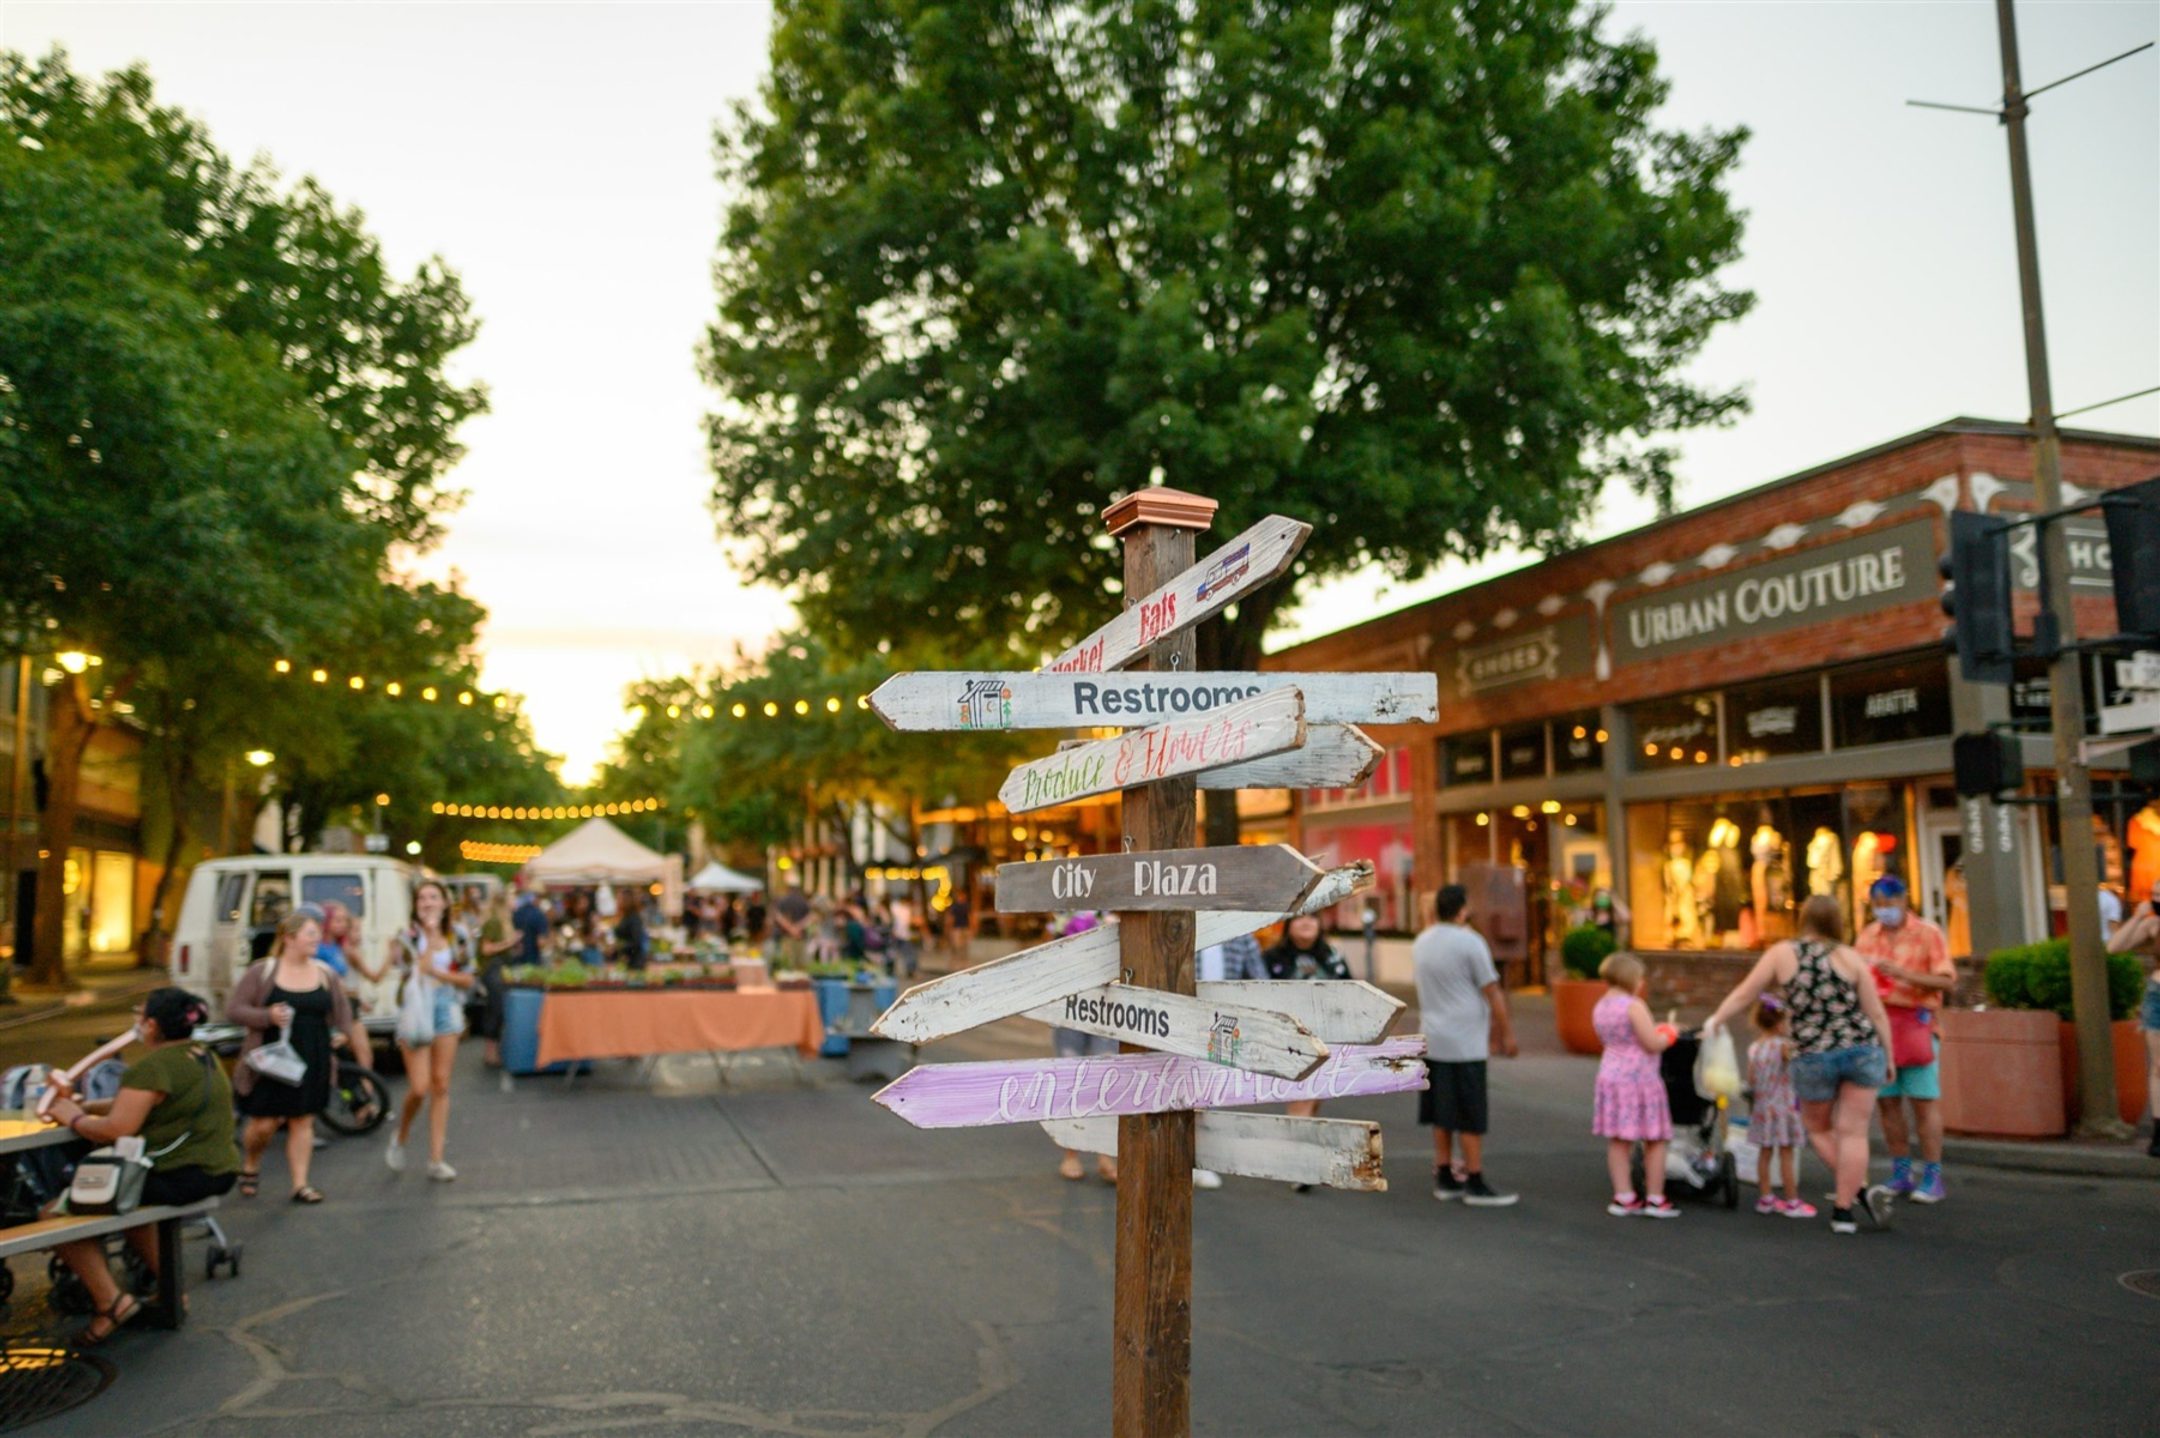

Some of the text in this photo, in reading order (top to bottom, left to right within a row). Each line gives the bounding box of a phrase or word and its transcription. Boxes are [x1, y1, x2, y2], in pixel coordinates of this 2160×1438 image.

[1052, 592, 1176, 672] rket Eats
[1630, 546, 1905, 648] URBAN COUTURE
[1022, 719, 1250, 807] Produce & Flowers
[1052, 860, 1217, 899] City Plaza
[1065, 994, 1169, 1037] Restrooms
